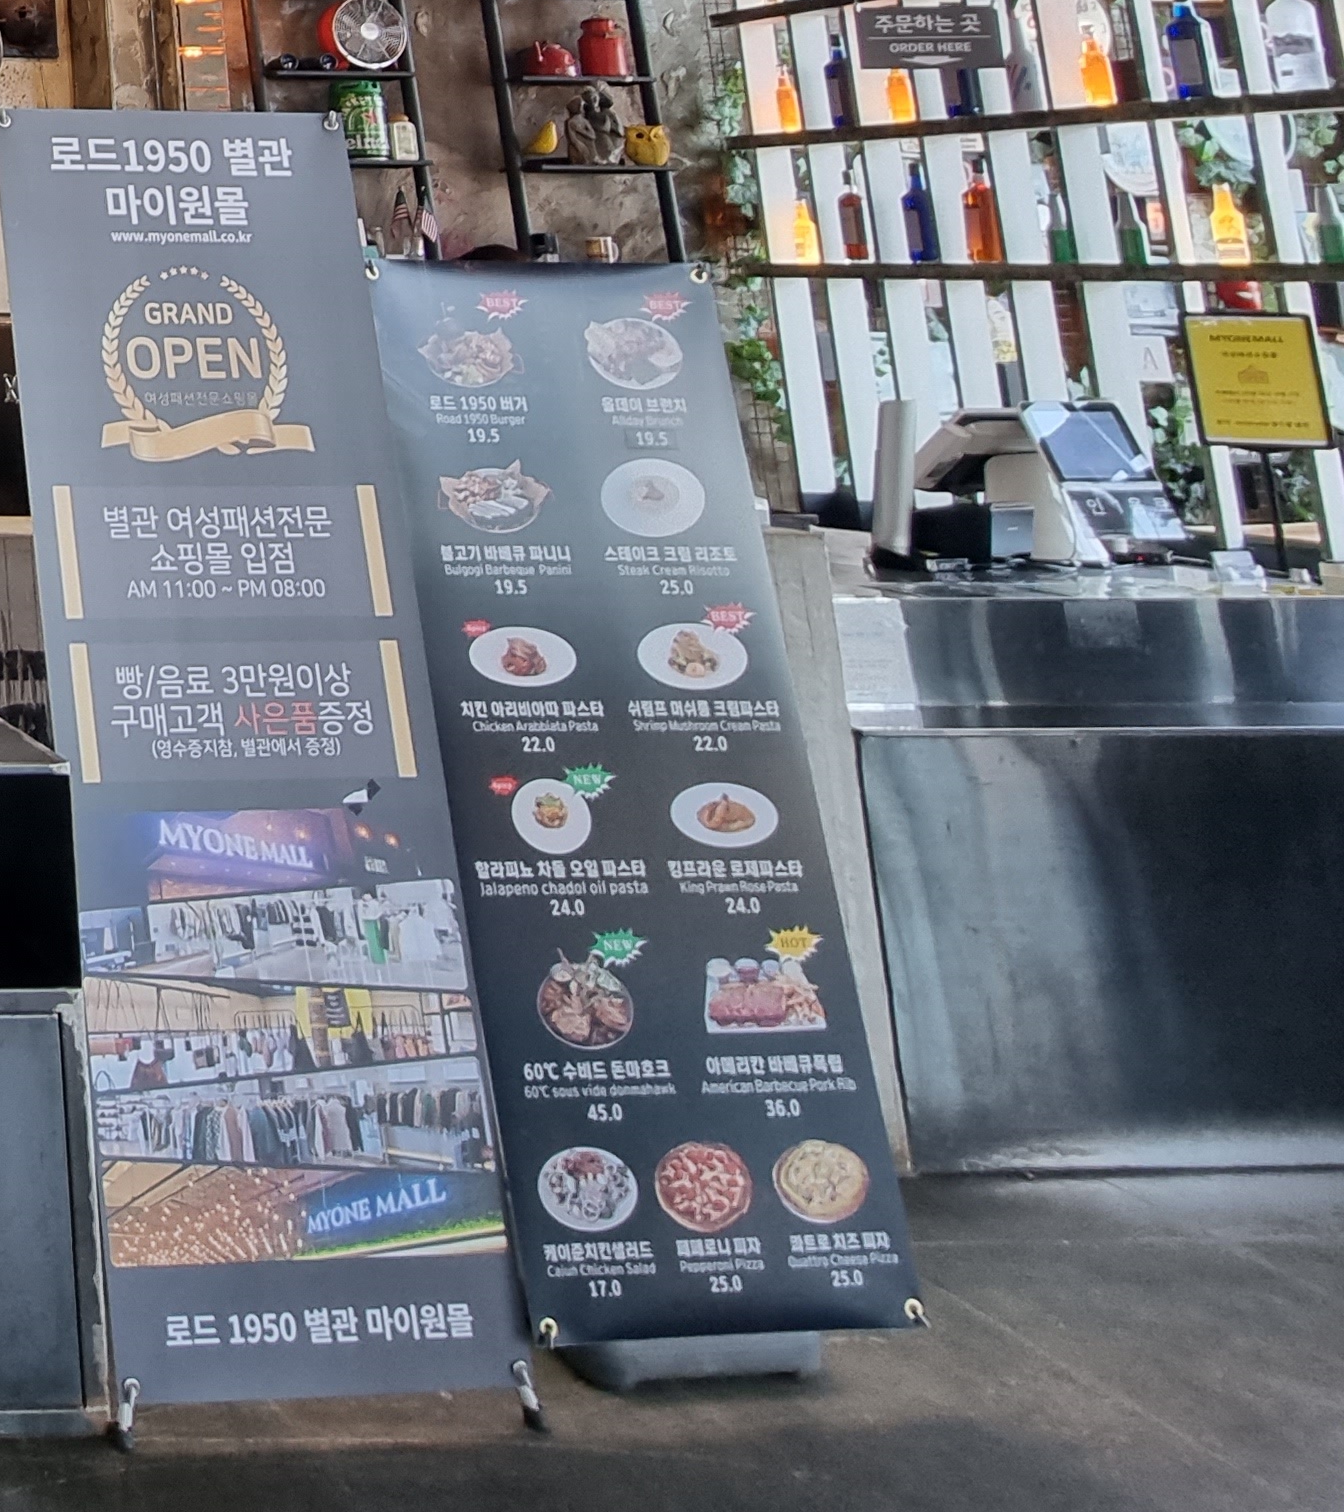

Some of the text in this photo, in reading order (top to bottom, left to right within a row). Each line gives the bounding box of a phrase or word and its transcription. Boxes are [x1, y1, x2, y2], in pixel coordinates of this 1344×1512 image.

[875, 14, 981, 33] 주문하는 곳
[890, 42, 971, 53] ORDER HERE
[50, 137, 292, 176] 로드1950 별관
[106, 186, 249, 225] 마이원몰
[111, 230, 252, 244] www.myonemall.co.kr
[144, 303, 233, 324] GRAND
[127, 337, 262, 379] OPEN
[430, 396, 528, 411] 로드 1950 버거
[468, 429, 500, 443] 19.5
[103, 506, 333, 539] 별관 여성패션전문
[151, 541, 294, 575] 쇼핑몰 입점
[127, 579, 325, 598] AM 11:00 PM 08:00
[660, 580, 693, 595] 25.0
[116, 663, 351, 699] 빵/음료 3만원이상
[111, 700, 373, 737] 구매고객 사은품증정
[521, 737, 555, 752] 22.0
[693, 736, 727, 751] 22.0
[572, 774, 601, 785] NEW
[158, 819, 312, 868] MYONE MALL
[725, 897, 760, 914] 24.0
[587, 1103, 623, 1122] 45.0
[766, 1099, 800, 1117] 36.0
[307, 1178, 446, 1235] MYONE MALL
[710, 1275, 742, 1292] 25.0
[831, 1270, 863, 1287] 25.0
[589, 1280, 622, 1297] 17.0
[166, 1303, 473, 1347] 로드 1950 별관 마이원몰
